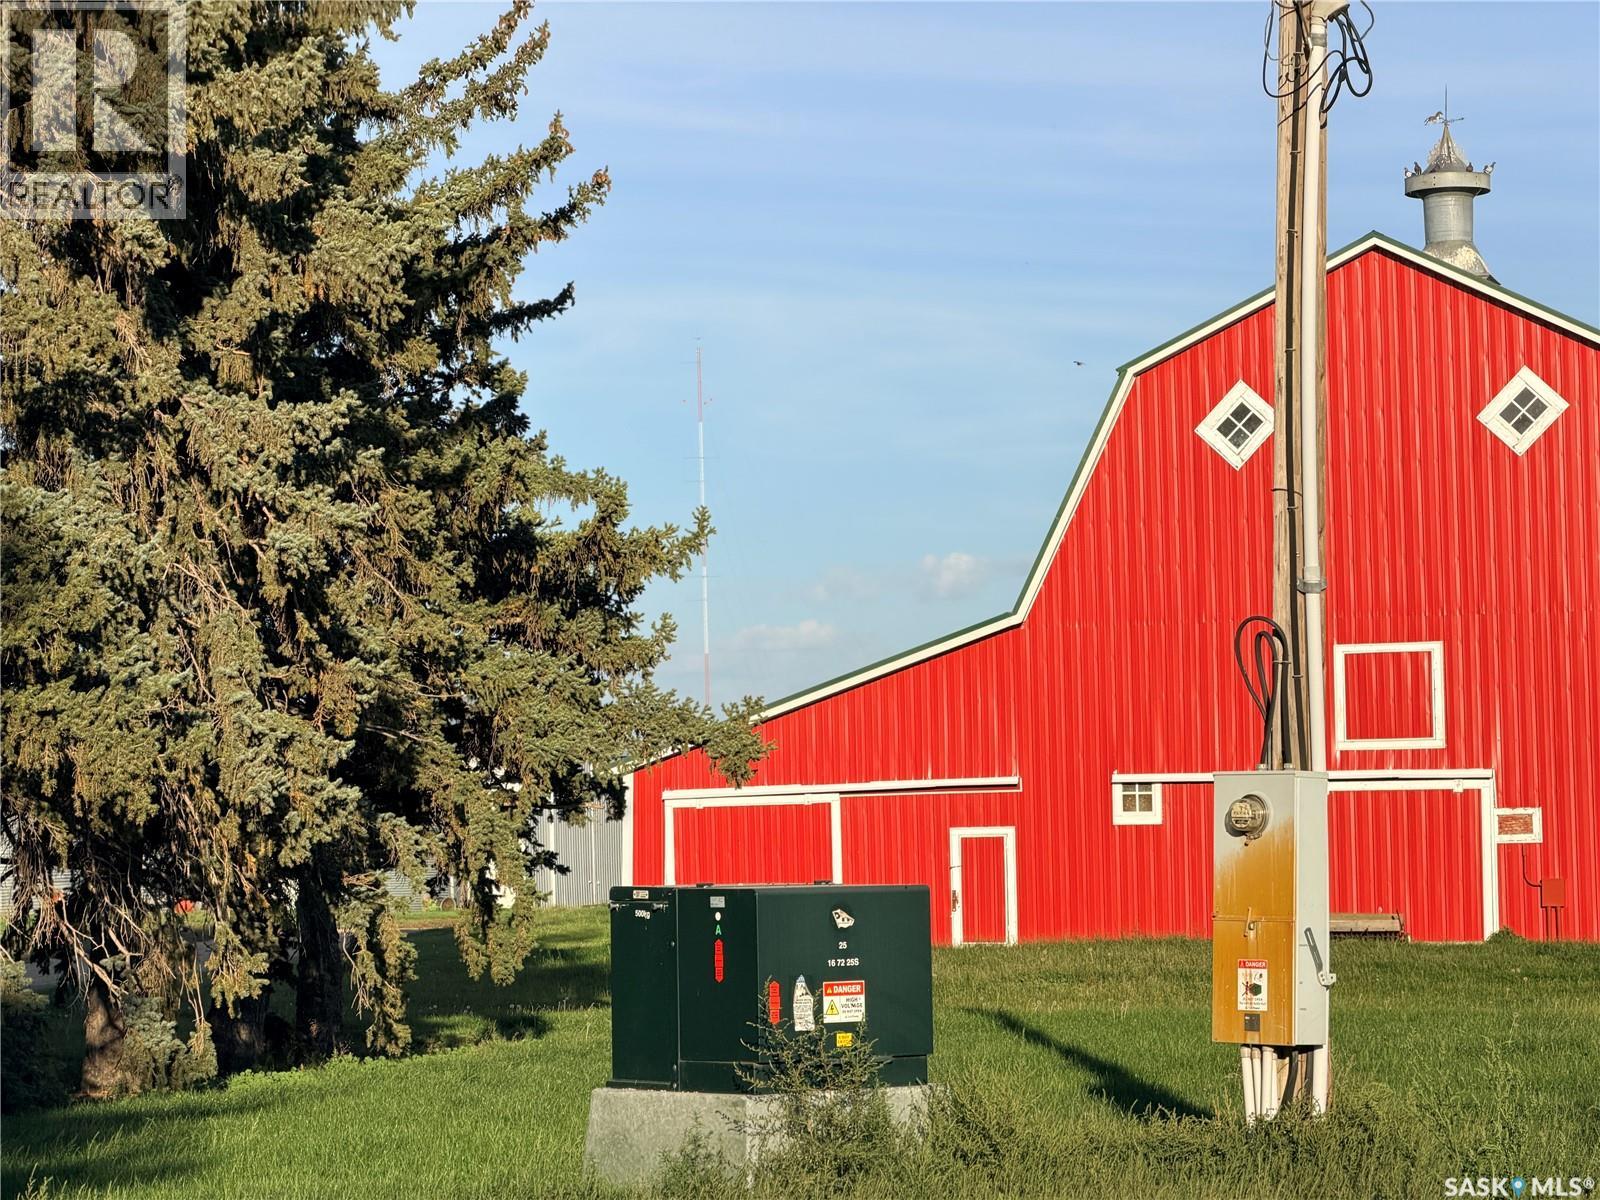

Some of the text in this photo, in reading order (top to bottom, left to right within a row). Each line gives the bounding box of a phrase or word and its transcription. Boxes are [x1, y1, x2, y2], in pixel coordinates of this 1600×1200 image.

[635, 909, 650, 920] 500kg
[715, 924, 722, 936] A
[838, 941, 848, 949] 25
[828, 959, 836, 967] 16
[837, 959, 845, 967] 72
[833, 985, 861, 994] DANGER
